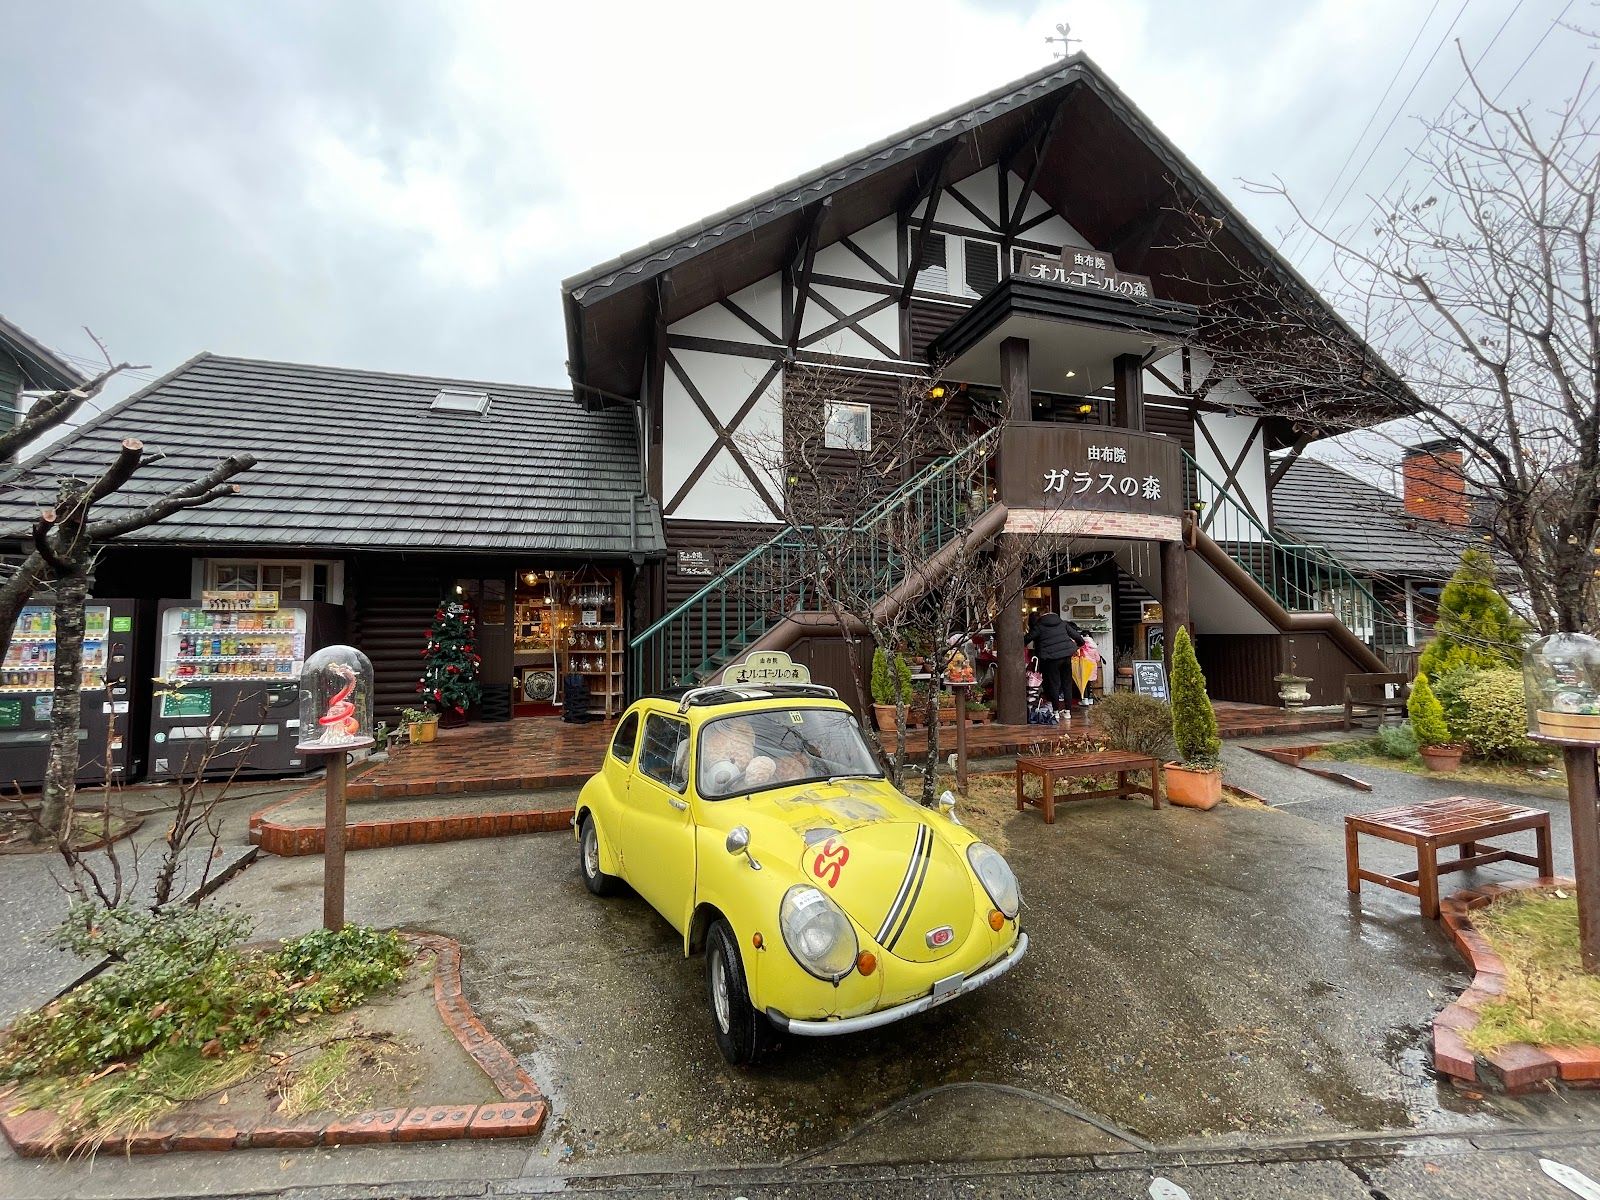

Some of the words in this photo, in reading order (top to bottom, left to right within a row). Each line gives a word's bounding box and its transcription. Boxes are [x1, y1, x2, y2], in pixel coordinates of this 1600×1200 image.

[1074, 253, 1106, 270] 由布院
[1028, 264, 1148, 297] オルゴールの森
[1087, 445, 1127, 464] 由布院
[1043, 468, 1161, 500] ガラスの森
[814, 838, 850, 888] SS
